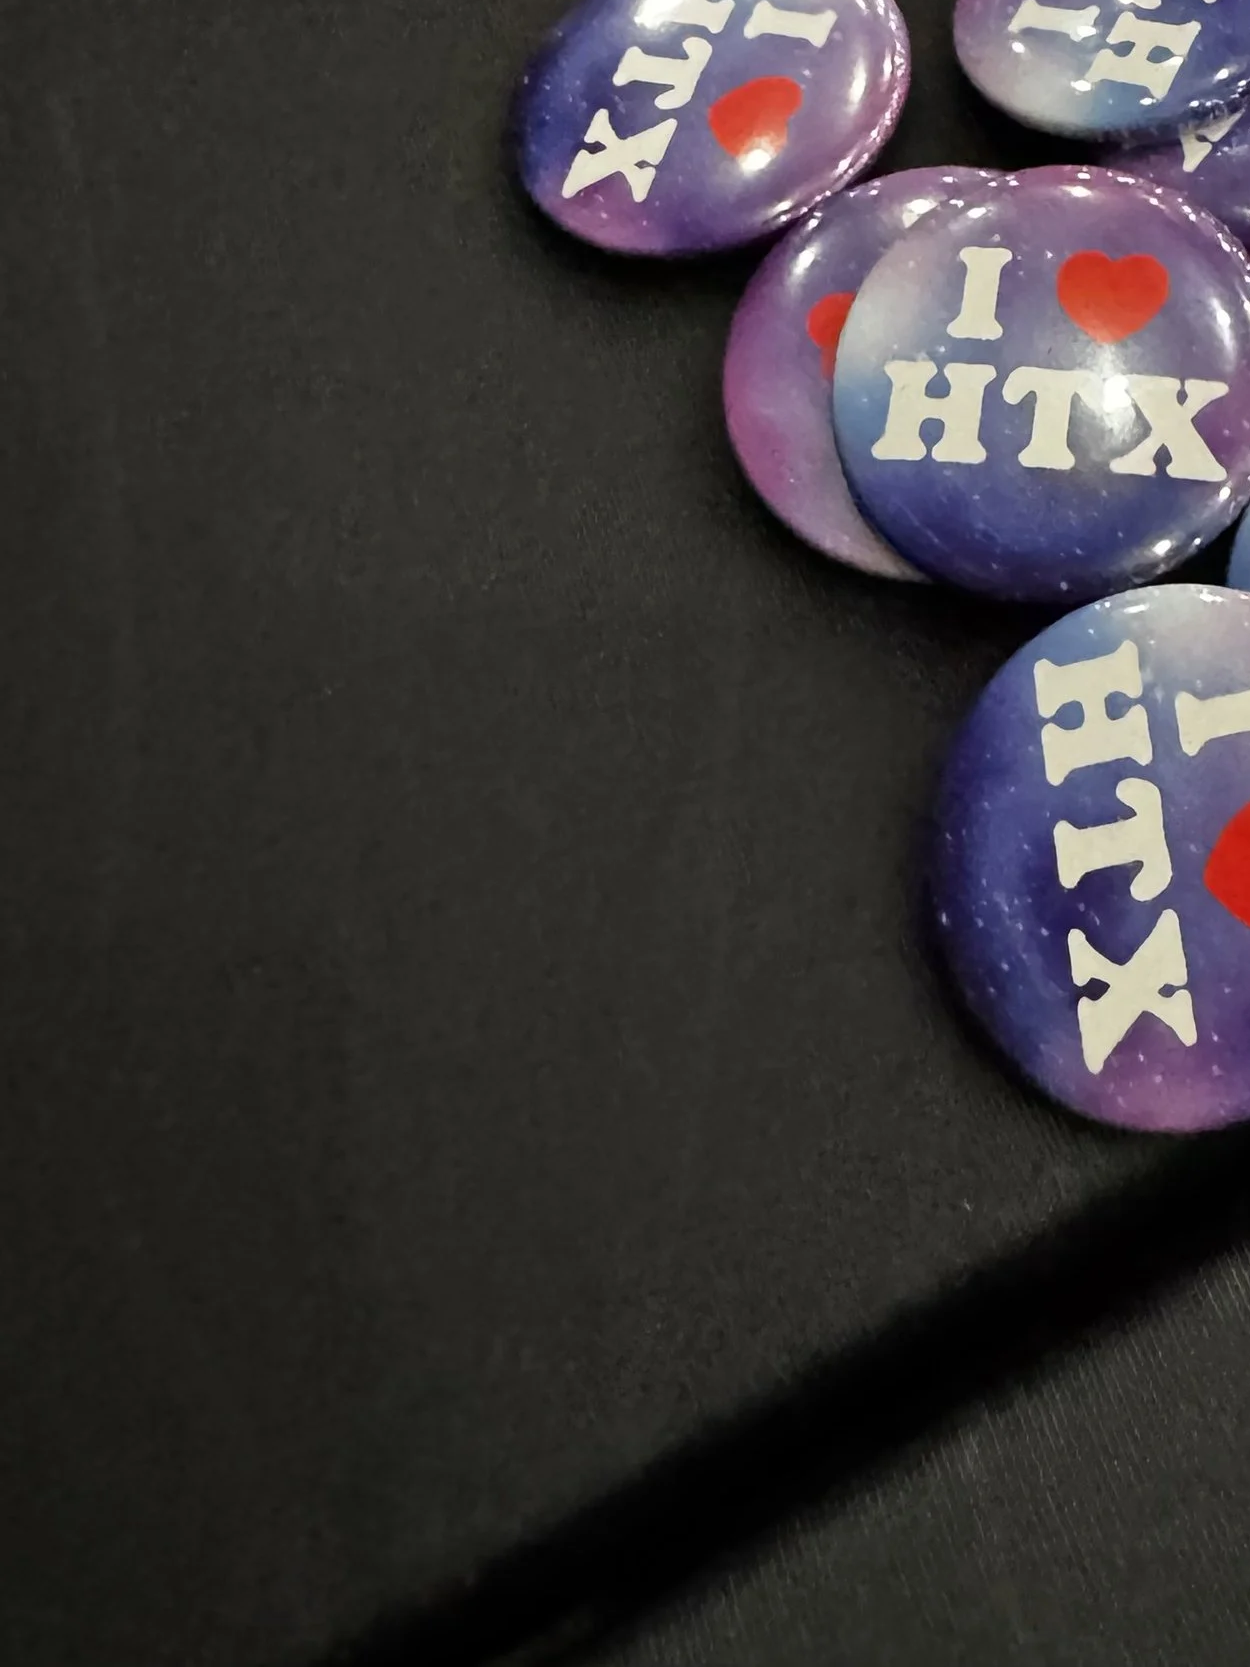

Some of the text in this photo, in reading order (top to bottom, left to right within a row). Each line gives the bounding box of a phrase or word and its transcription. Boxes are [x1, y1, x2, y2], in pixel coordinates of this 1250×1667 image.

[744, 0, 838, 48] I
[946, 246, 1013, 340] I
[871, 360, 1230, 482] HTX
[1033, 640, 1198, 1075] HTX
